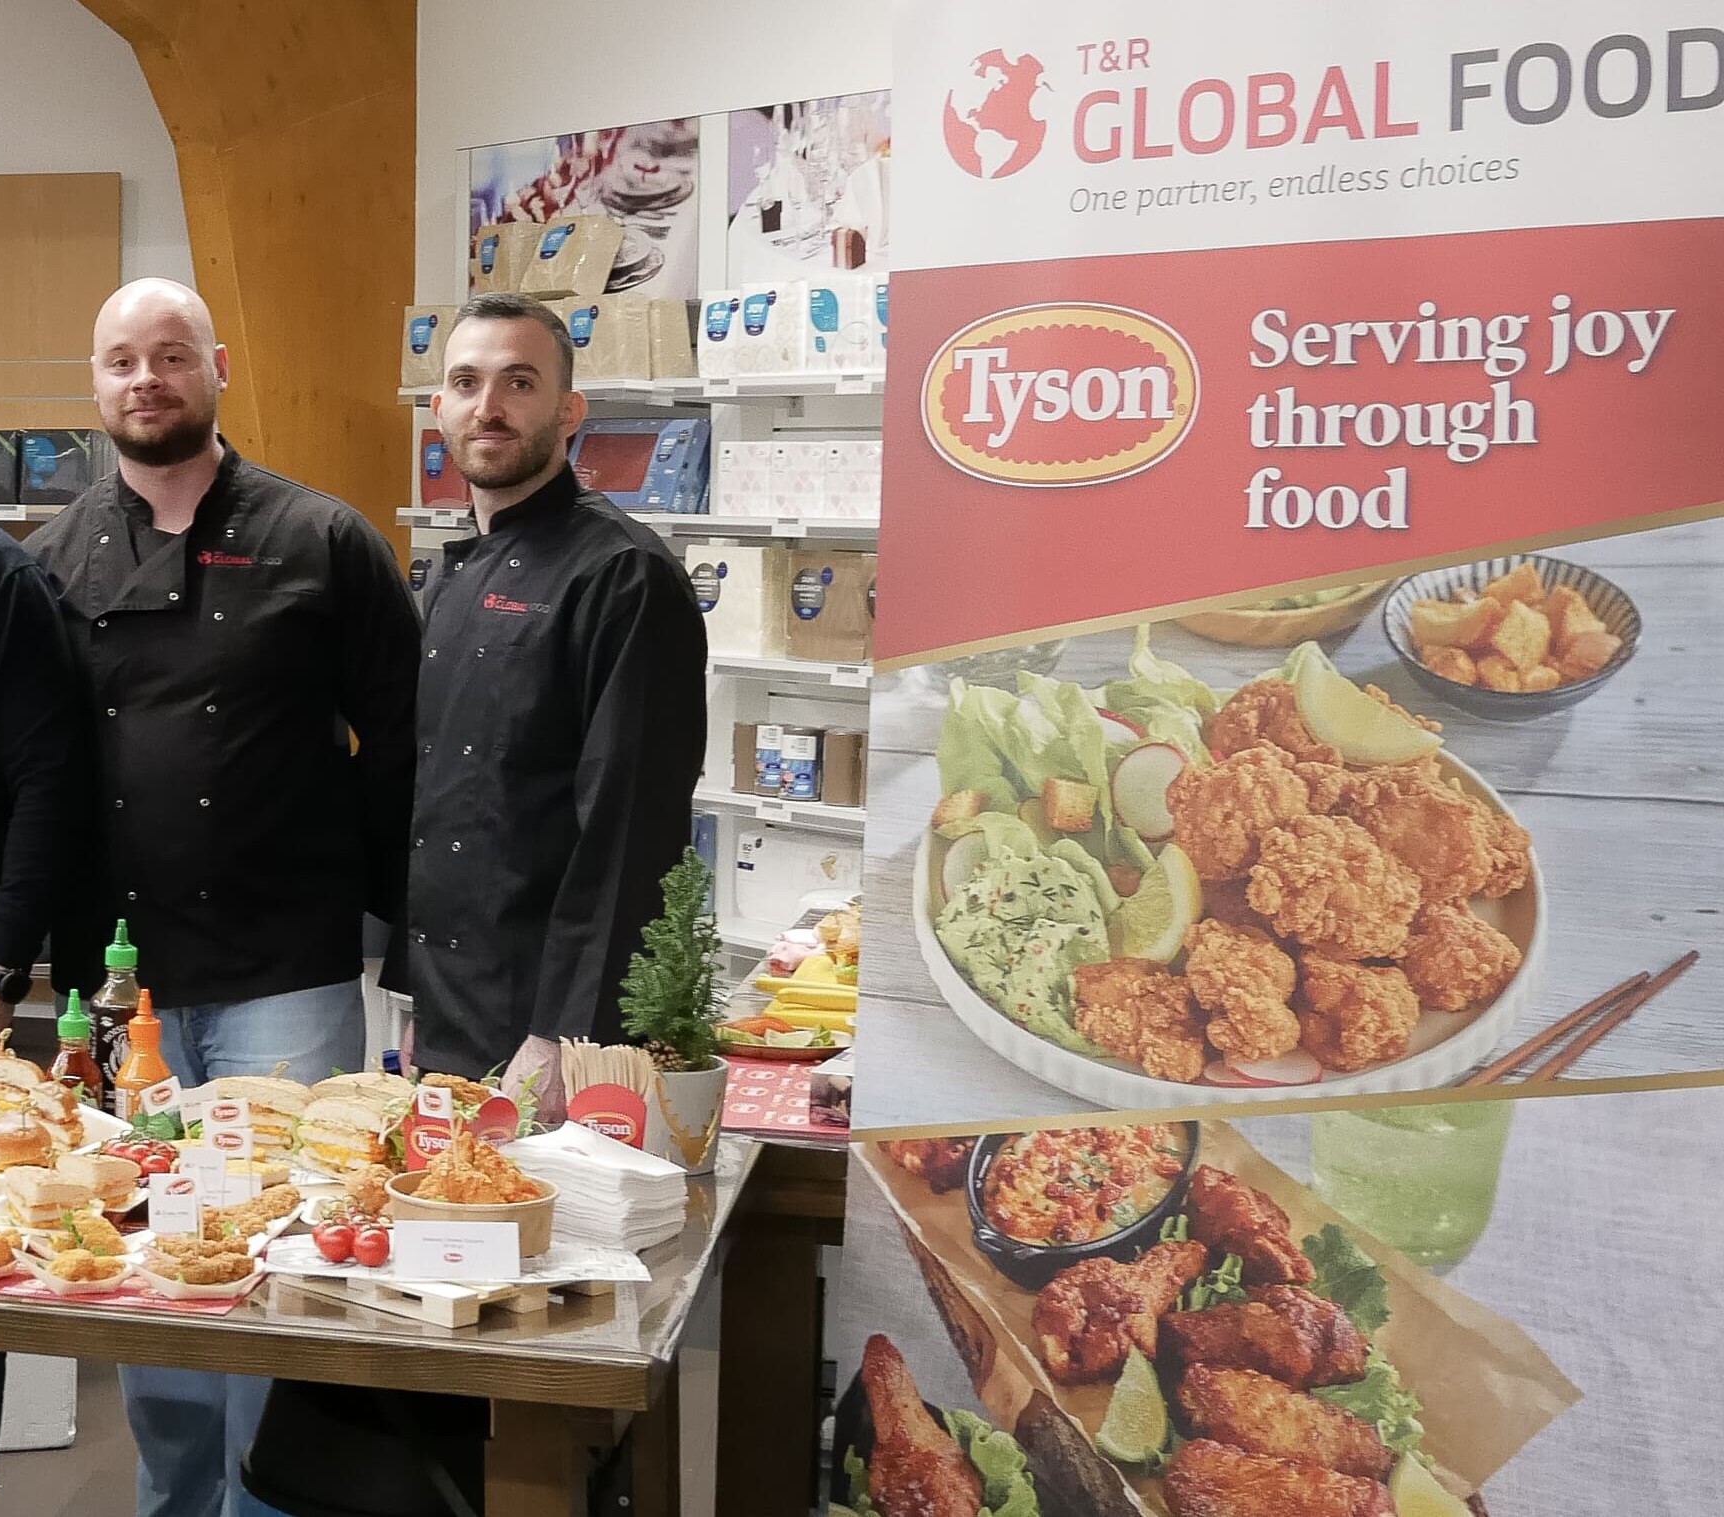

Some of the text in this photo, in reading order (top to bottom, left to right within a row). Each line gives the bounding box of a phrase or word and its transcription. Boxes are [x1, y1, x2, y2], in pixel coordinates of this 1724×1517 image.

[1072, 27, 1724, 164] GLOBAL FOOD
[1076, 37, 1150, 76] T&R
[1068, 154, 1520, 216] One partner, endless choices
[1249, 293, 1677, 378] Serving joy
[953, 346, 1175, 448] Tyson
[1245, 380, 1539, 463] through
[1243, 465, 1410, 530] food
